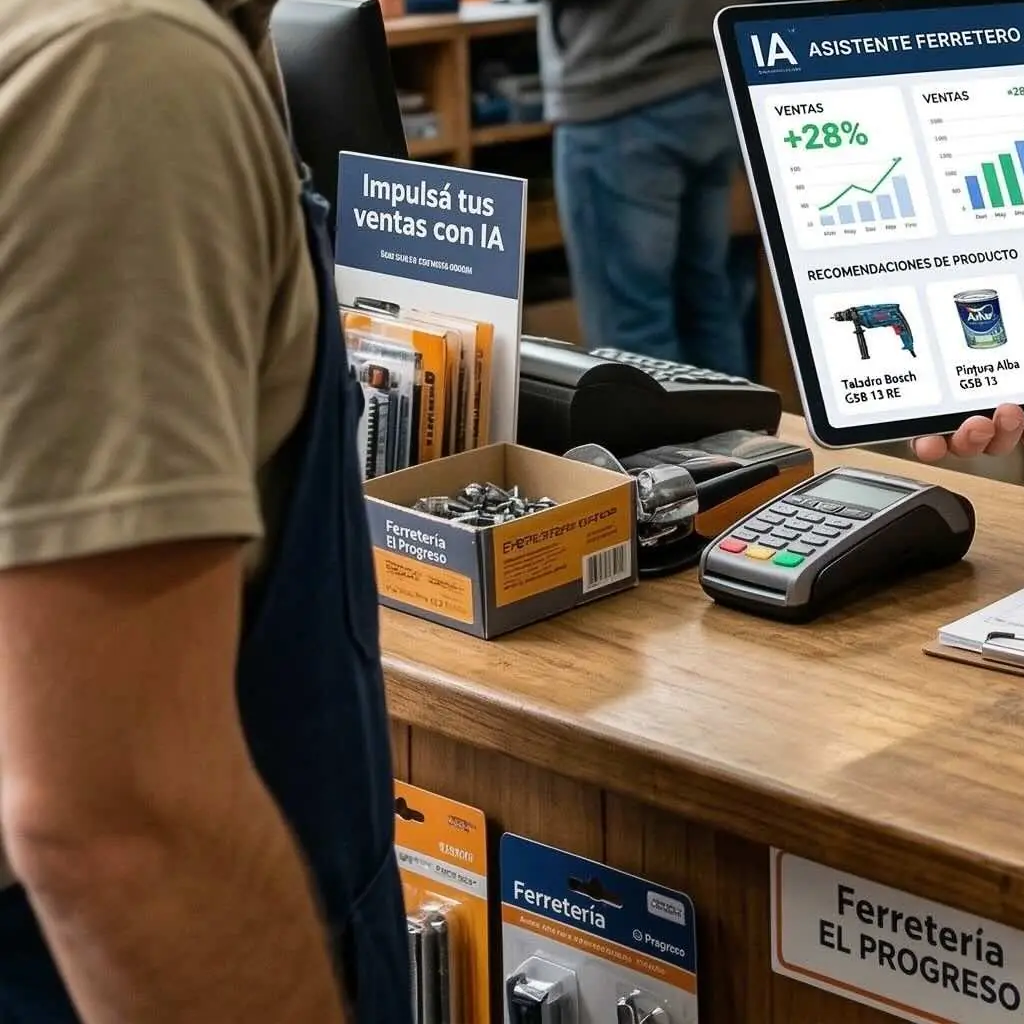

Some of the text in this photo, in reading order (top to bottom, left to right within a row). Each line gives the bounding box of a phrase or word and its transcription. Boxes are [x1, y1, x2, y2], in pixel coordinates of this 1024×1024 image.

[751, 32, 799, 68] IA
[808, 27, 1021, 58] ASISTENTE FERRETERO
[774, 103, 825, 117] VENTAS
[922, 90, 970, 104] VENTAS
[783, 120, 869, 150] +28%
[363, 173, 495, 217] Impulsá tus
[353, 208, 505, 252] ventas con IA
[807, 248, 1019, 281] RECOMENDACIONES DE PRODUCTO
[885, 371, 917, 384] Bosch
[996, 359, 1021, 371] Alba
[844, 387, 902, 404] GSB 13 RE
[959, 376, 998, 390] GSB 13
[385, 519, 447, 550] Ferretería
[386, 534, 447, 564] El Progreso
[513, 879, 606, 930] Ferretería
[837, 883, 1005, 968] Ferretería
[819, 918, 1021, 1011] EL PROGRESO
